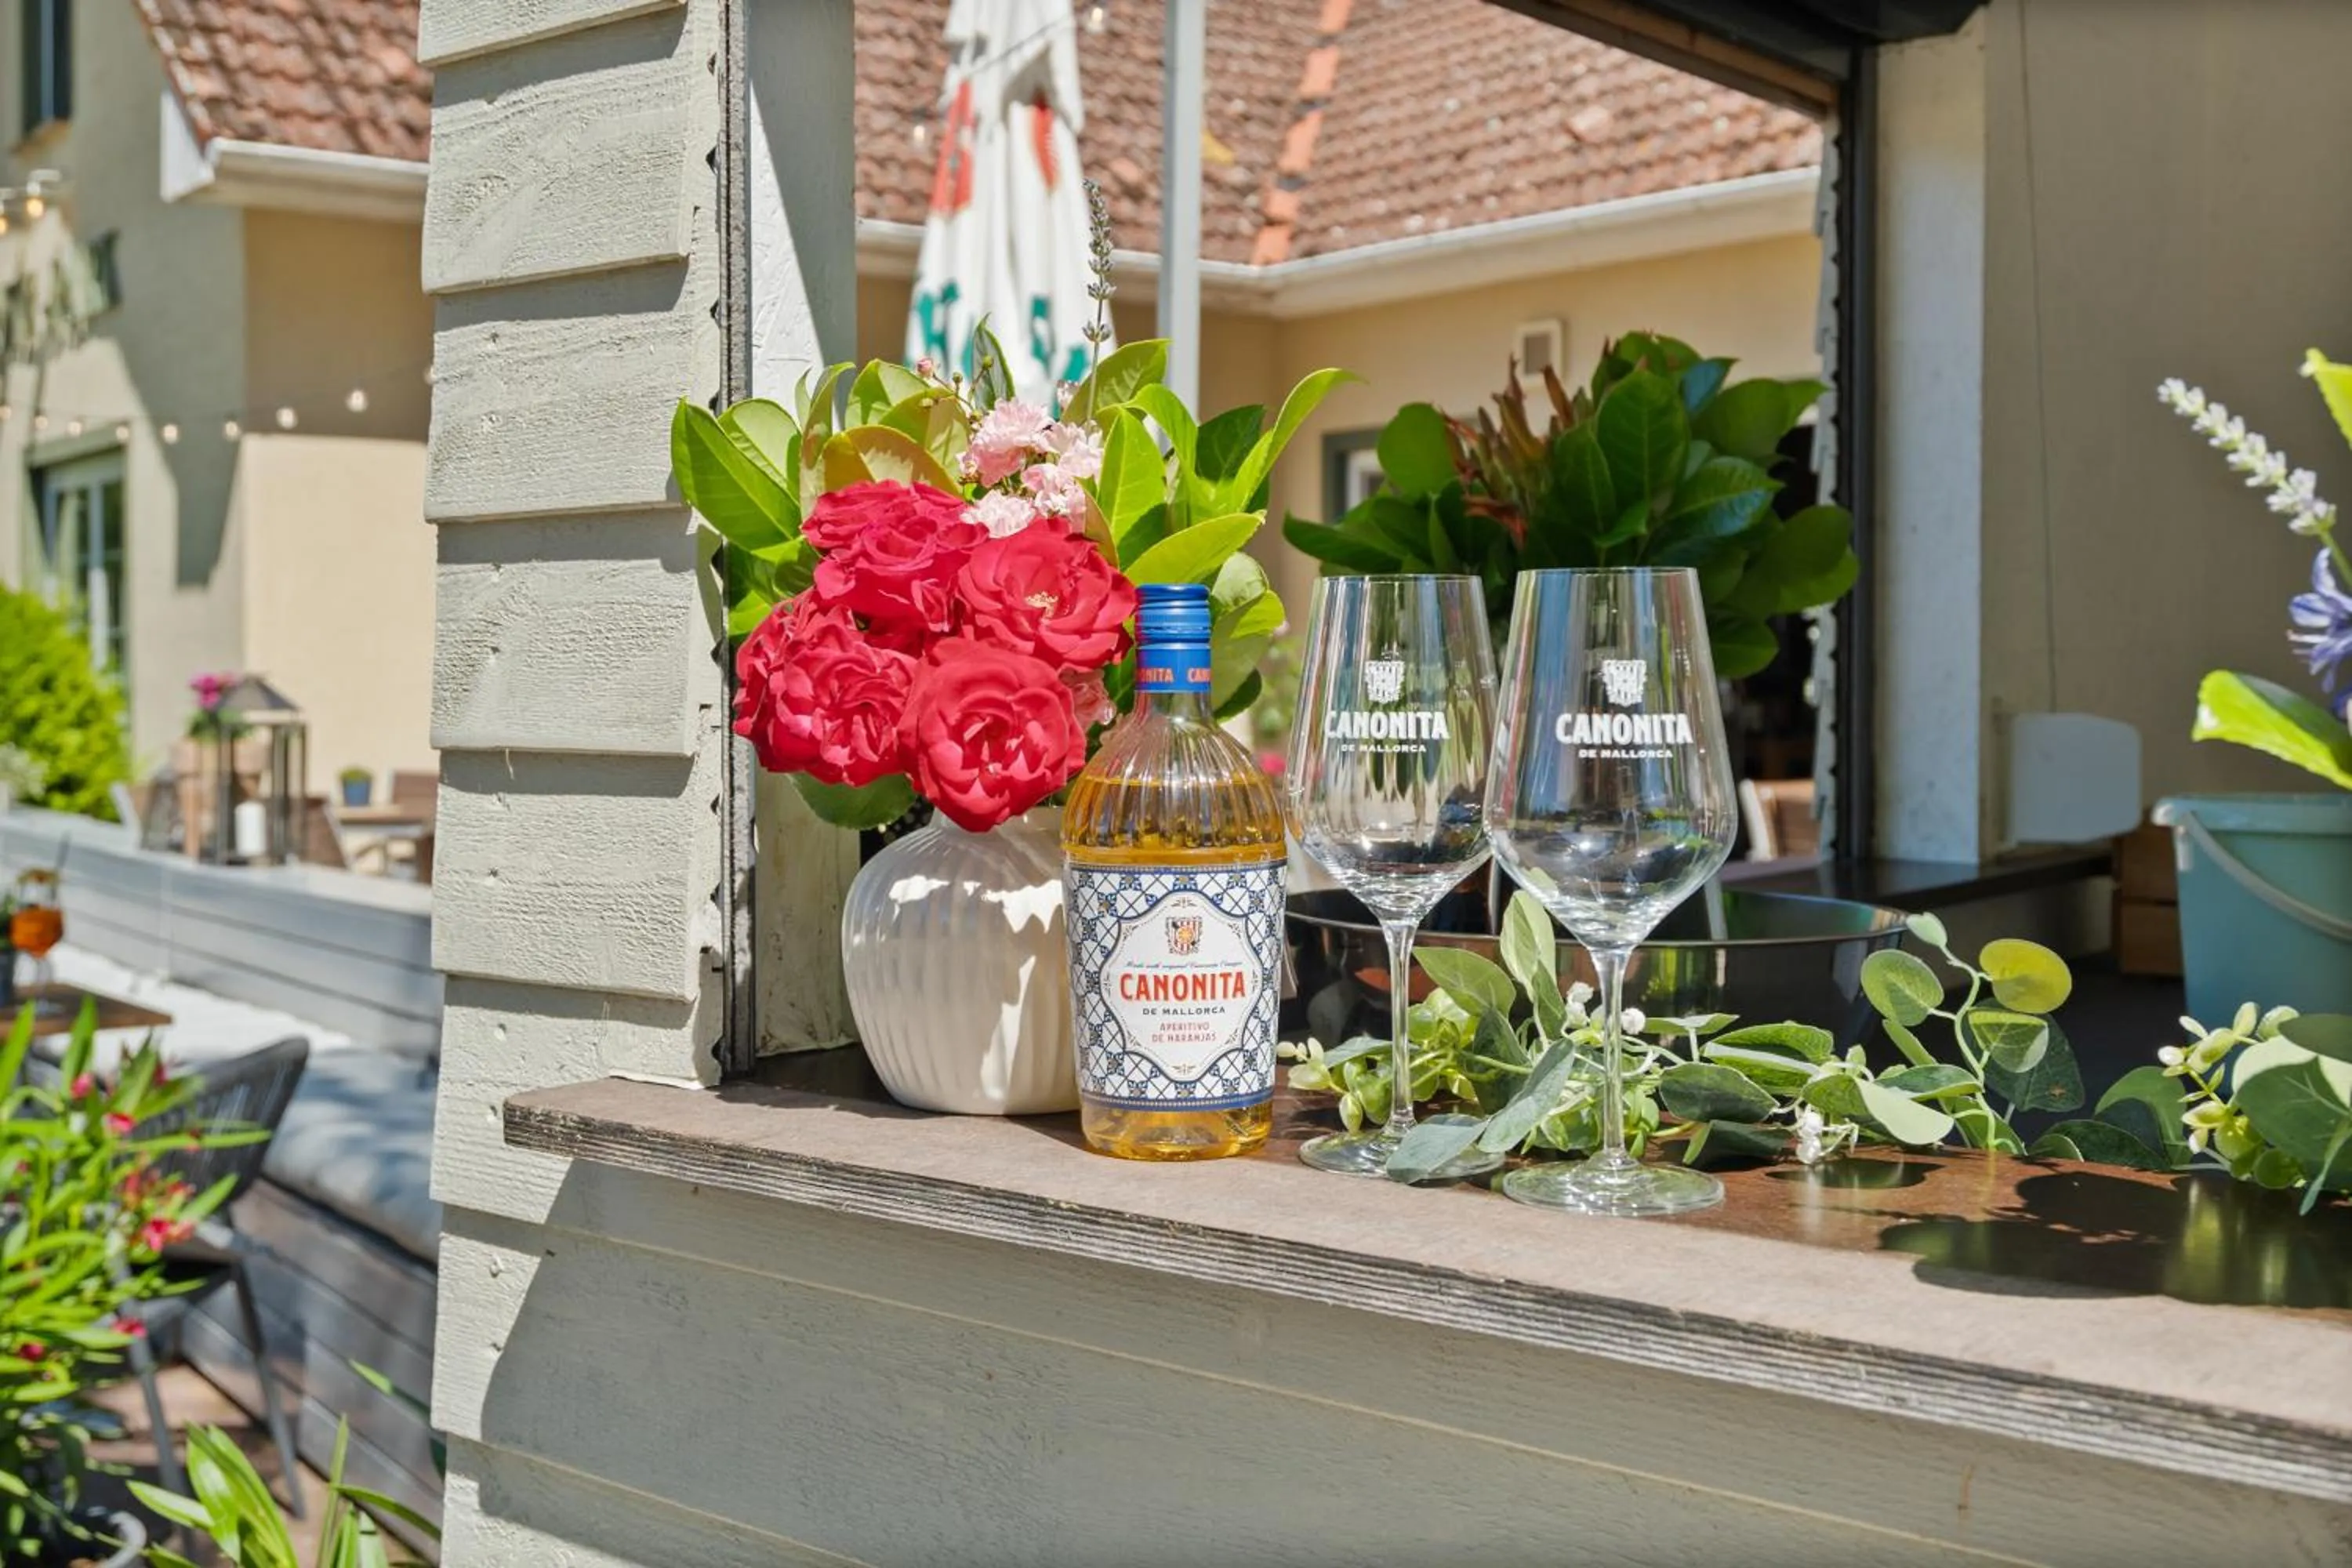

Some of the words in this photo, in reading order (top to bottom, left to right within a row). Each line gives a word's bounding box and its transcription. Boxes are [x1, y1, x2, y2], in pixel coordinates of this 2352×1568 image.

[1325, 710, 1450, 740] CANONITA
[1555, 712, 1694, 745] CANONITA
[1341, 744, 1356, 753] DE
[1359, 744, 1427, 753] MALLORCA
[1577, 749, 1597, 758] DE
[1600, 749, 1673, 758] MALLORCA
[1119, 971, 1246, 1002] CANONITA
[1142, 1007, 1157, 1016] DE
[1162, 1006, 1226, 1016] MALLORCA
[1160, 1021, 1210, 1032] APERITIVO
[1151, 1034, 1163, 1043] DE
[1167, 1032, 1217, 1044] NARANJAS
